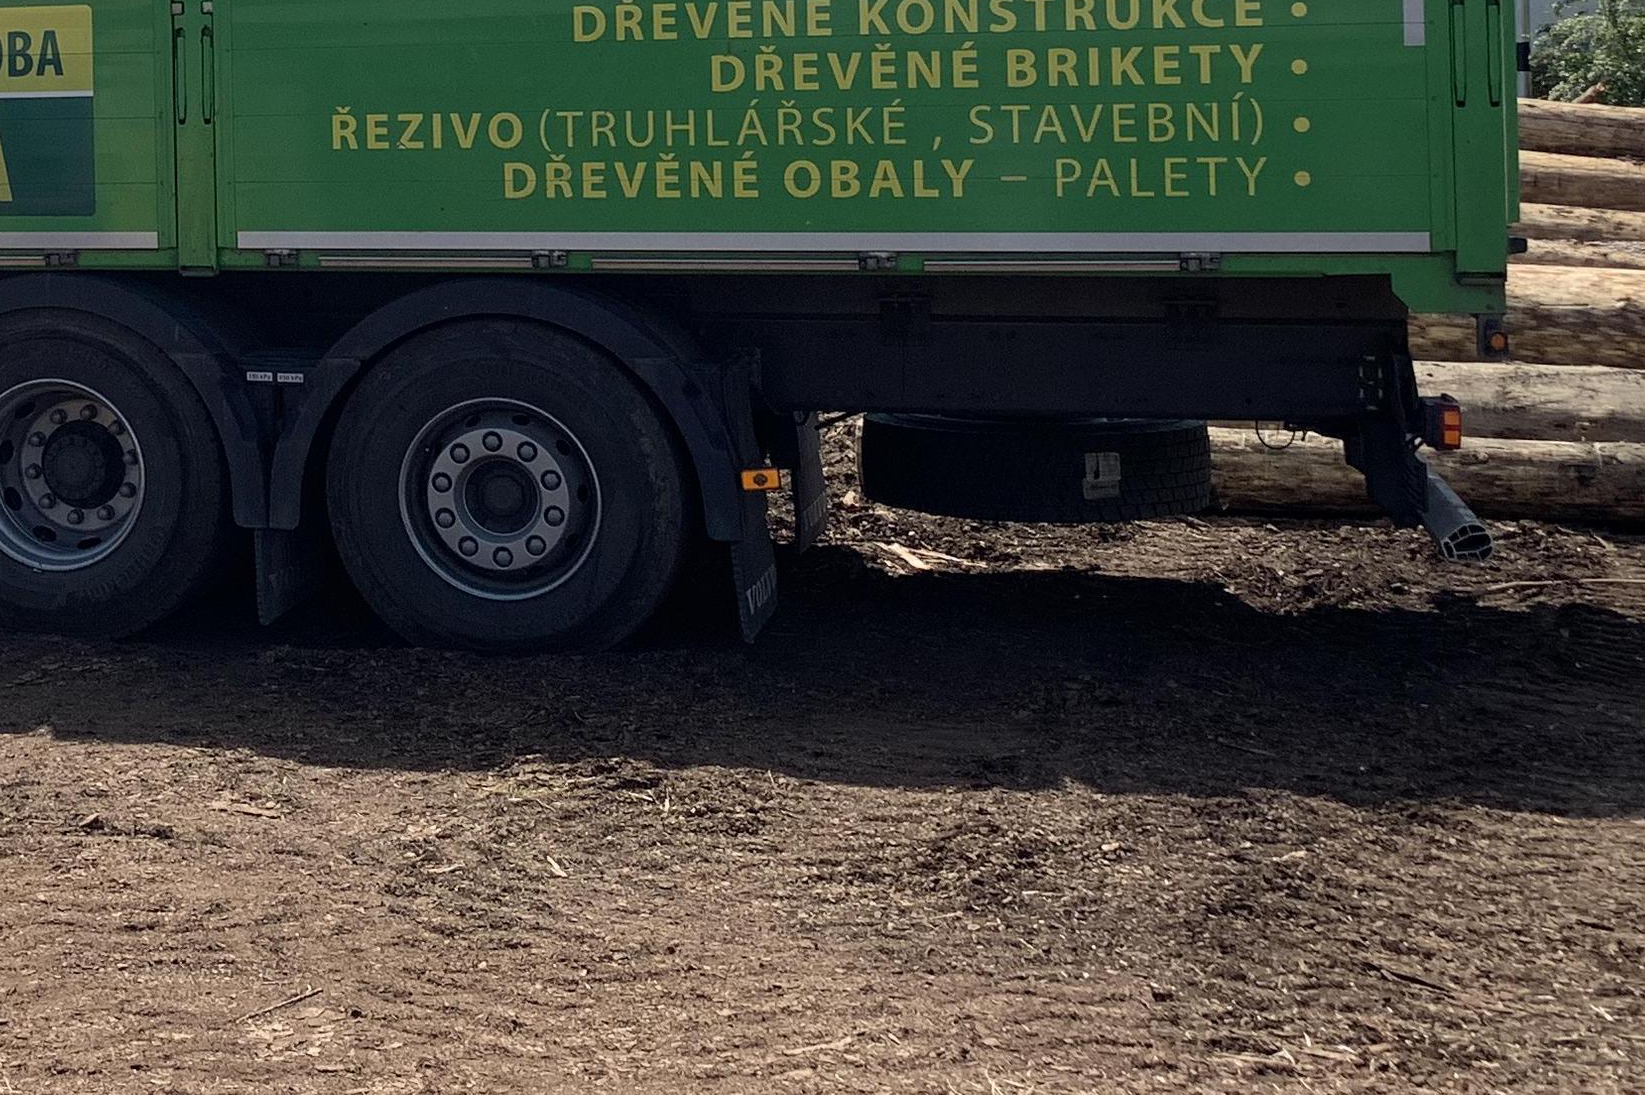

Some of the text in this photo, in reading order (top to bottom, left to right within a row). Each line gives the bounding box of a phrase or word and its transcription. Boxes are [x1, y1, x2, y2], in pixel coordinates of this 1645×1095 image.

[711, 42, 1264, 92] DŘEVĚNÉ BRIKETY
[331, 106, 523, 150] ŘEZIVO
[539, 98, 907, 154] (TRUHLÁŘSKÉ
[969, 91, 1263, 146] STAVEBNÍ)
[503, 150, 759, 199] DŘEVĚNÉ
[783, 159, 975, 198] OBALY
[1055, 156, 1268, 197] PALETY
